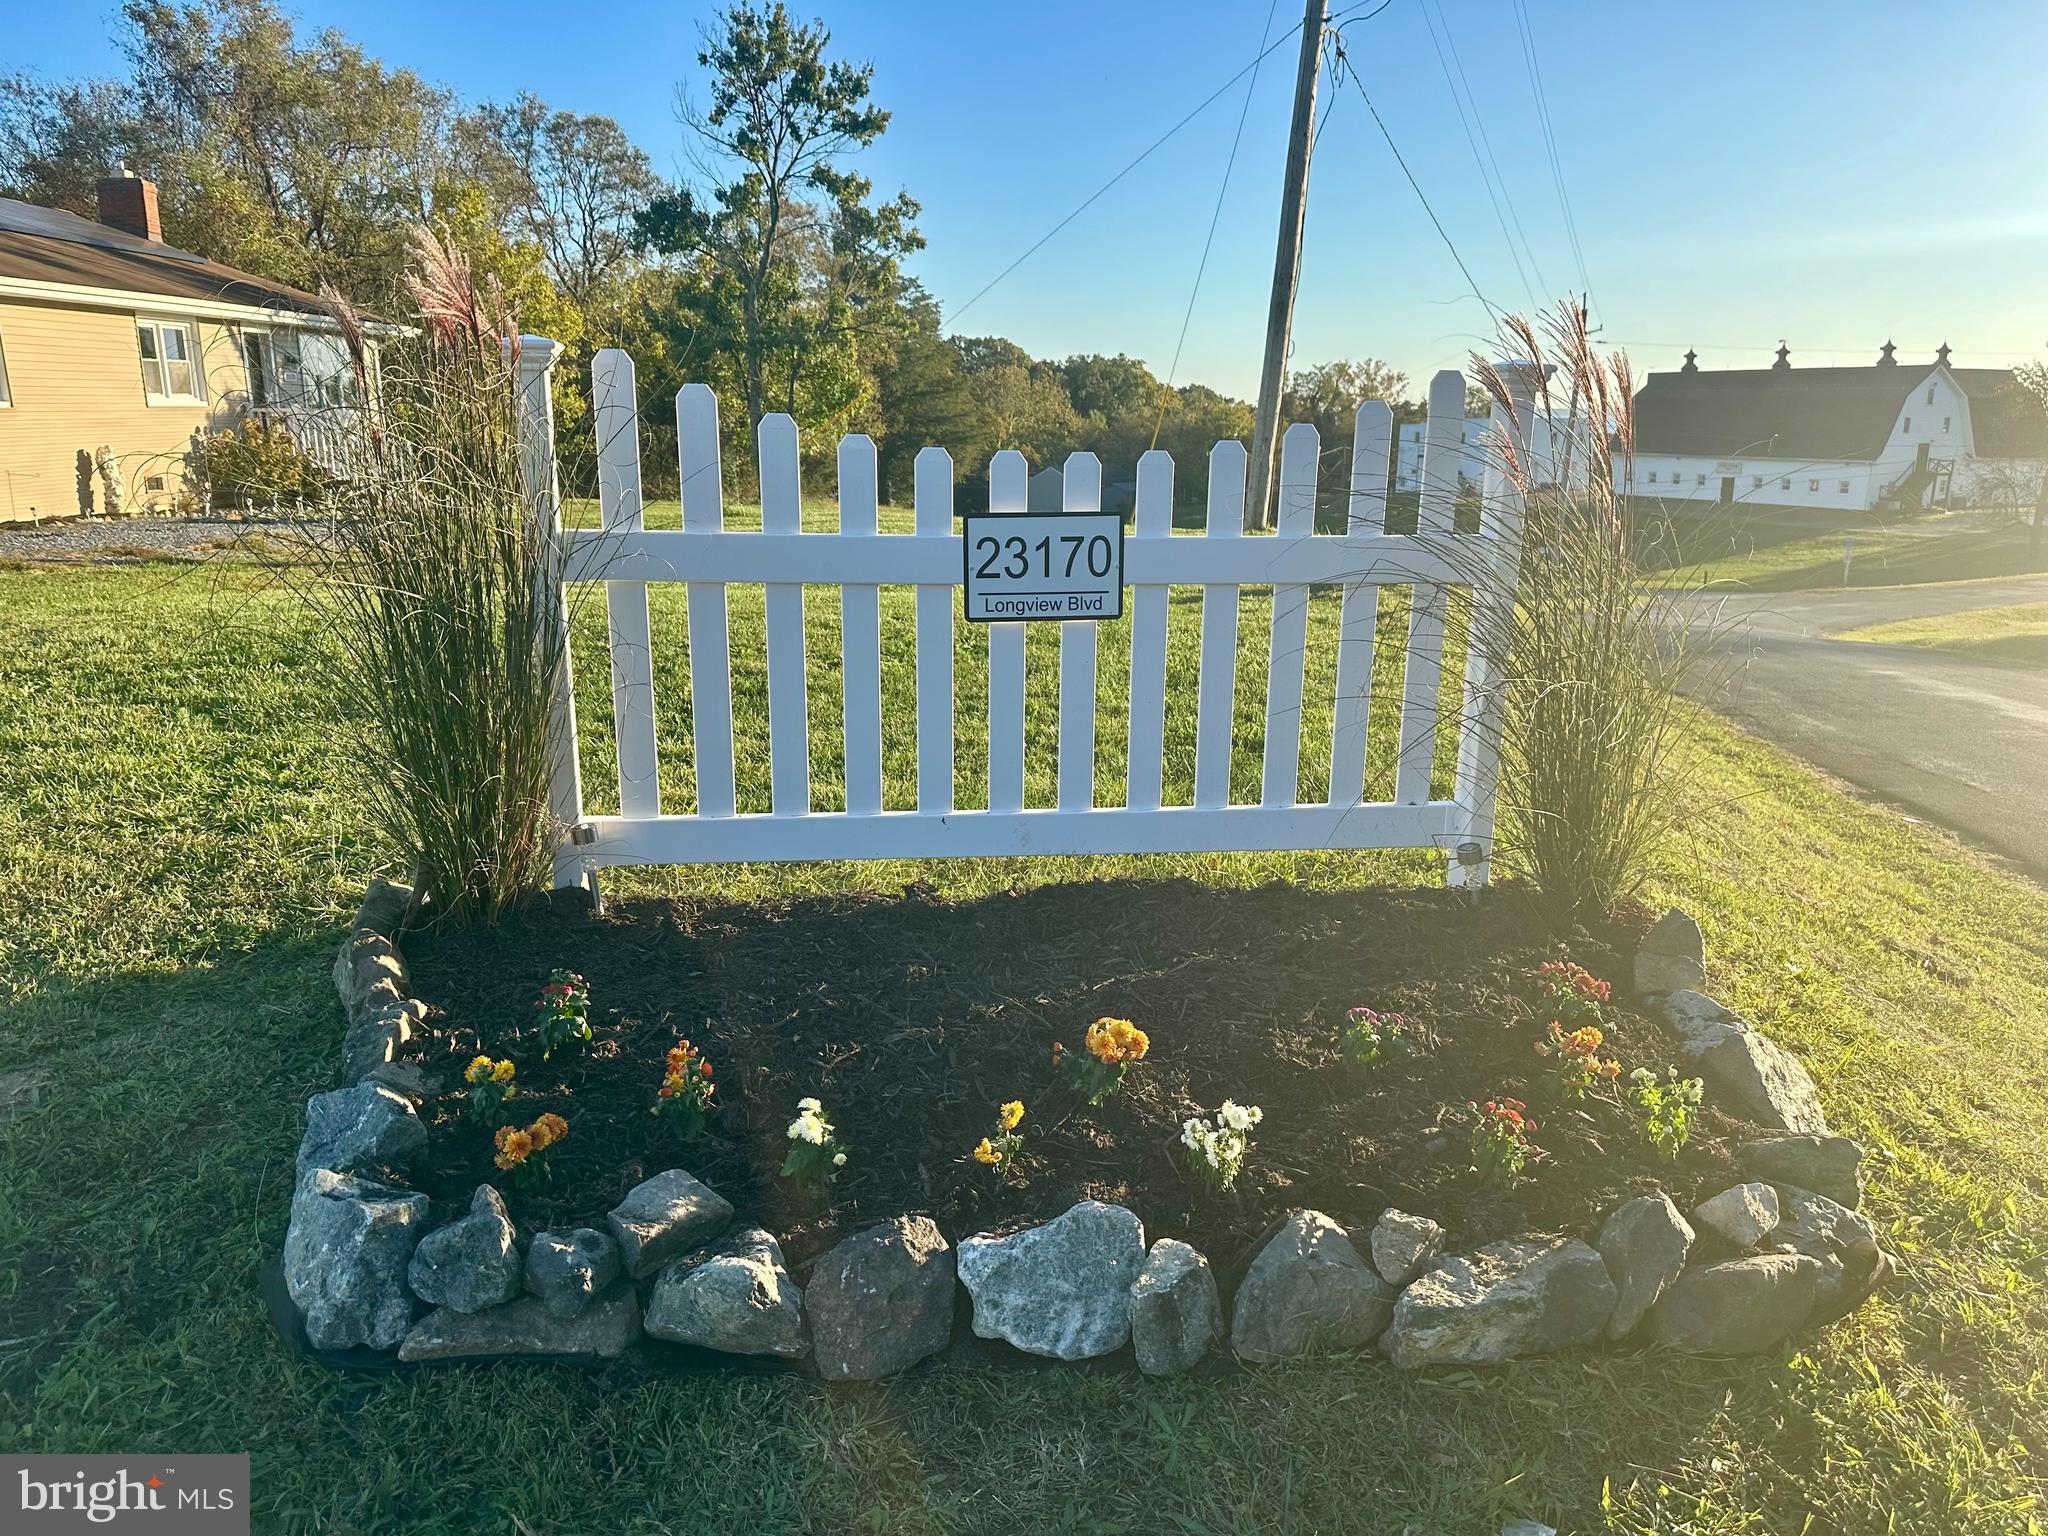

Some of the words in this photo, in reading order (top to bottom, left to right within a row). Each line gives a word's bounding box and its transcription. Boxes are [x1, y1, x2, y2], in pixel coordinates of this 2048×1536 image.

[975, 535, 1112, 579] 23170
[984, 597, 1063, 615] Longview
[1068, 596, 1103, 611] Blvd
